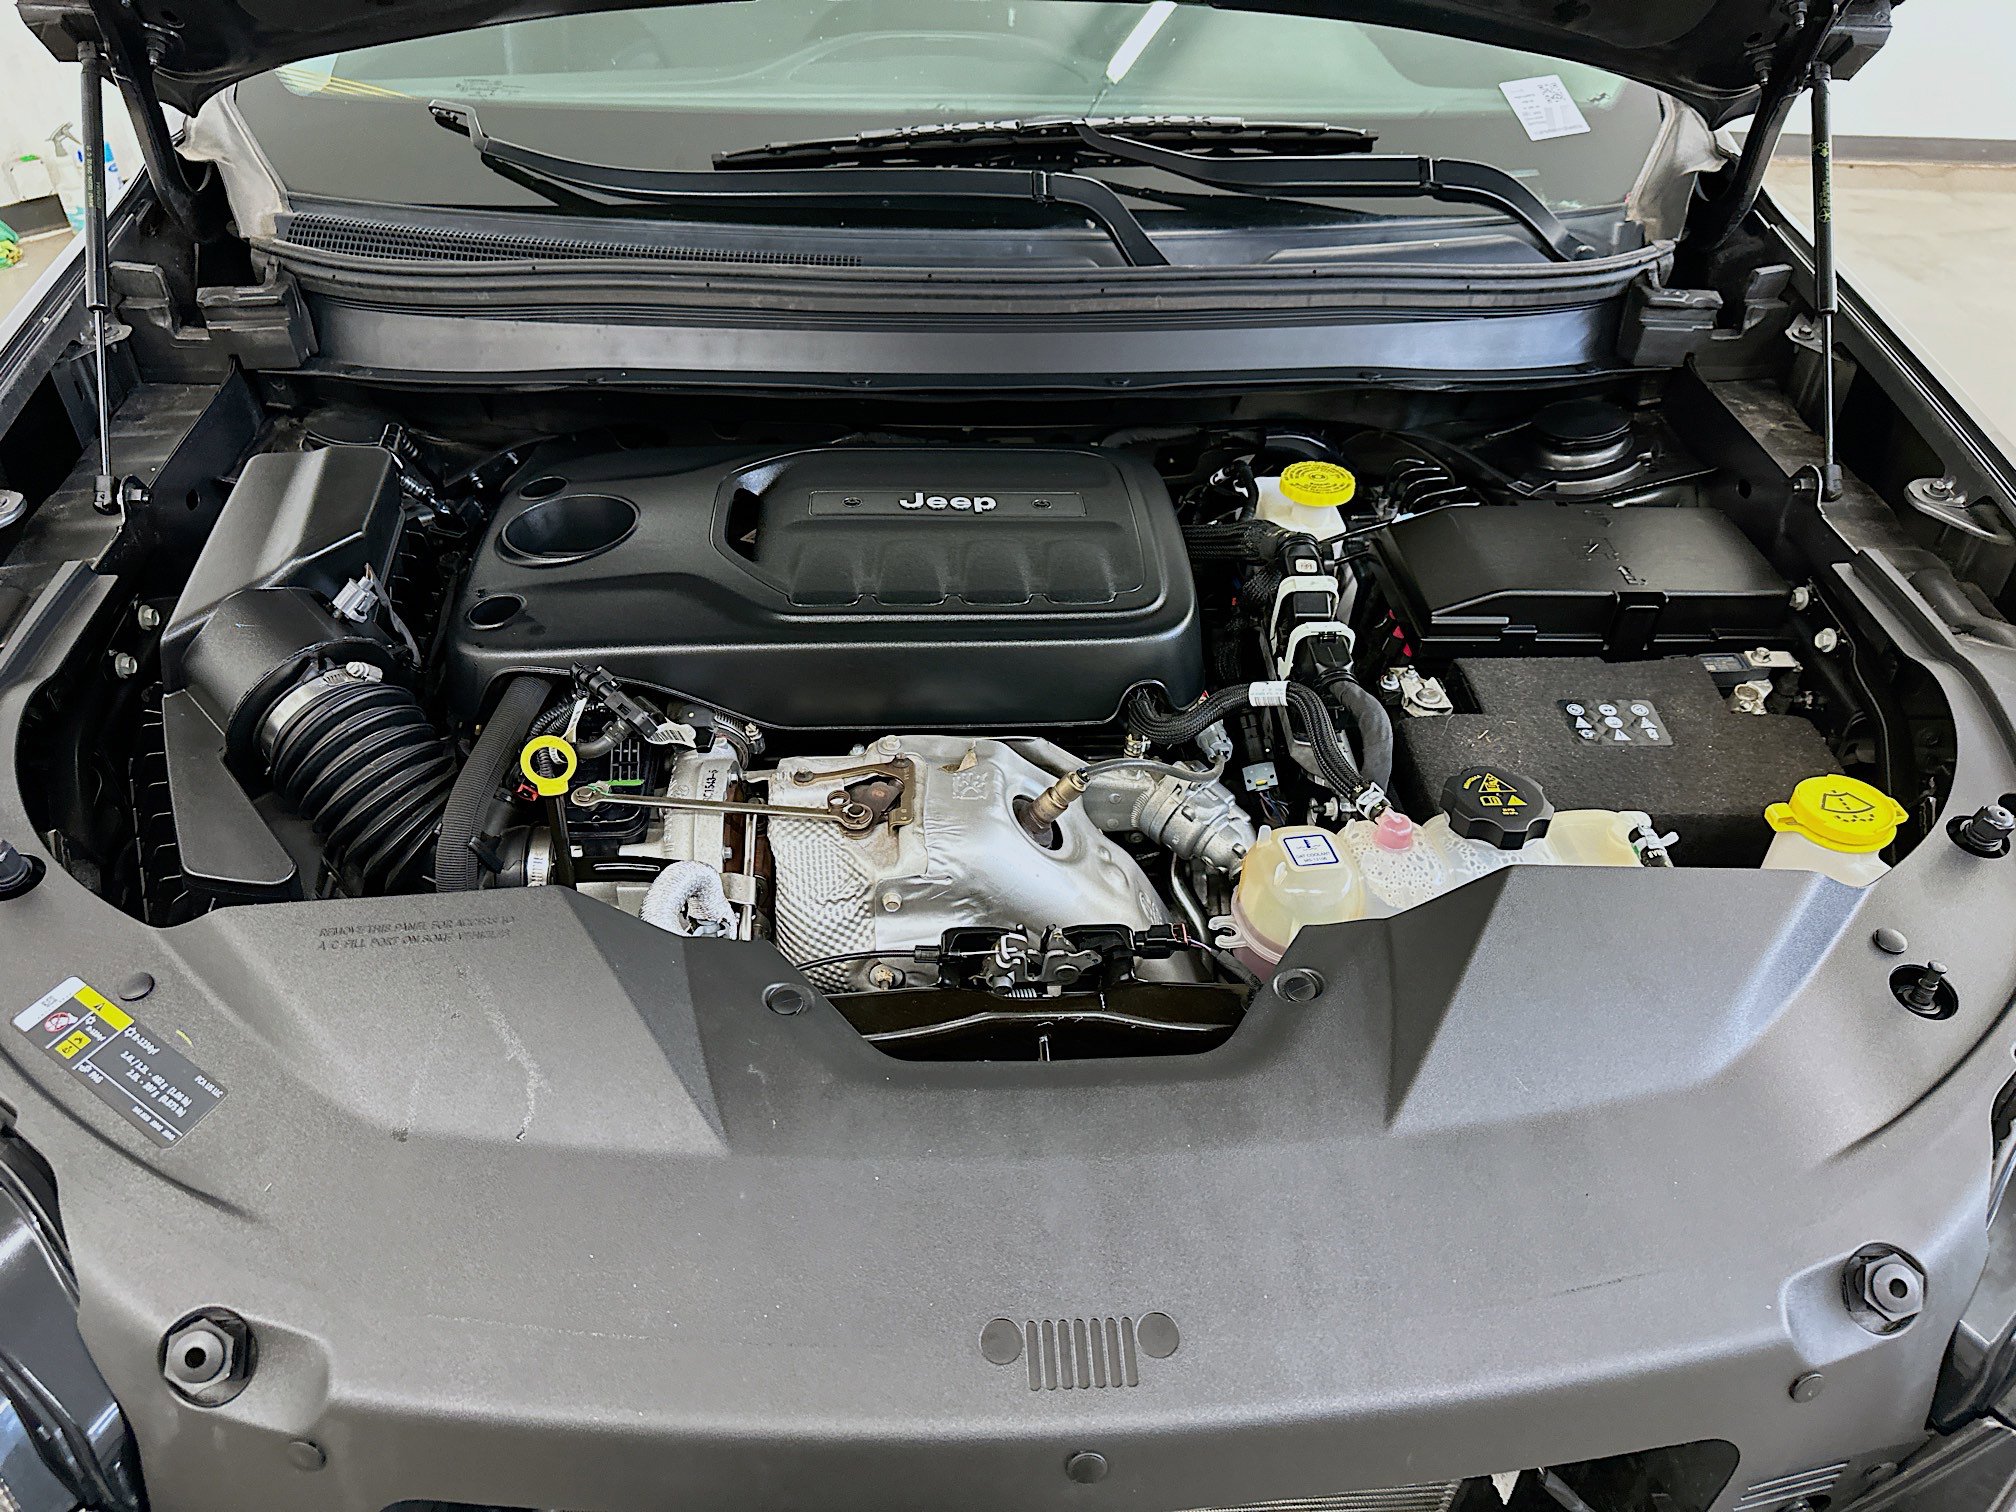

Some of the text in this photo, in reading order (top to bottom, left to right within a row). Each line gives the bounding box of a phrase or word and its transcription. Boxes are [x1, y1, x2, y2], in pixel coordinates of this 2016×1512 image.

[899, 492, 996, 513] Jeep
[319, 925, 363, 937] REMOVE
[366, 923, 391, 934] THIS
[318, 939, 340, 951] AC
[344, 938, 367, 949] FILL
